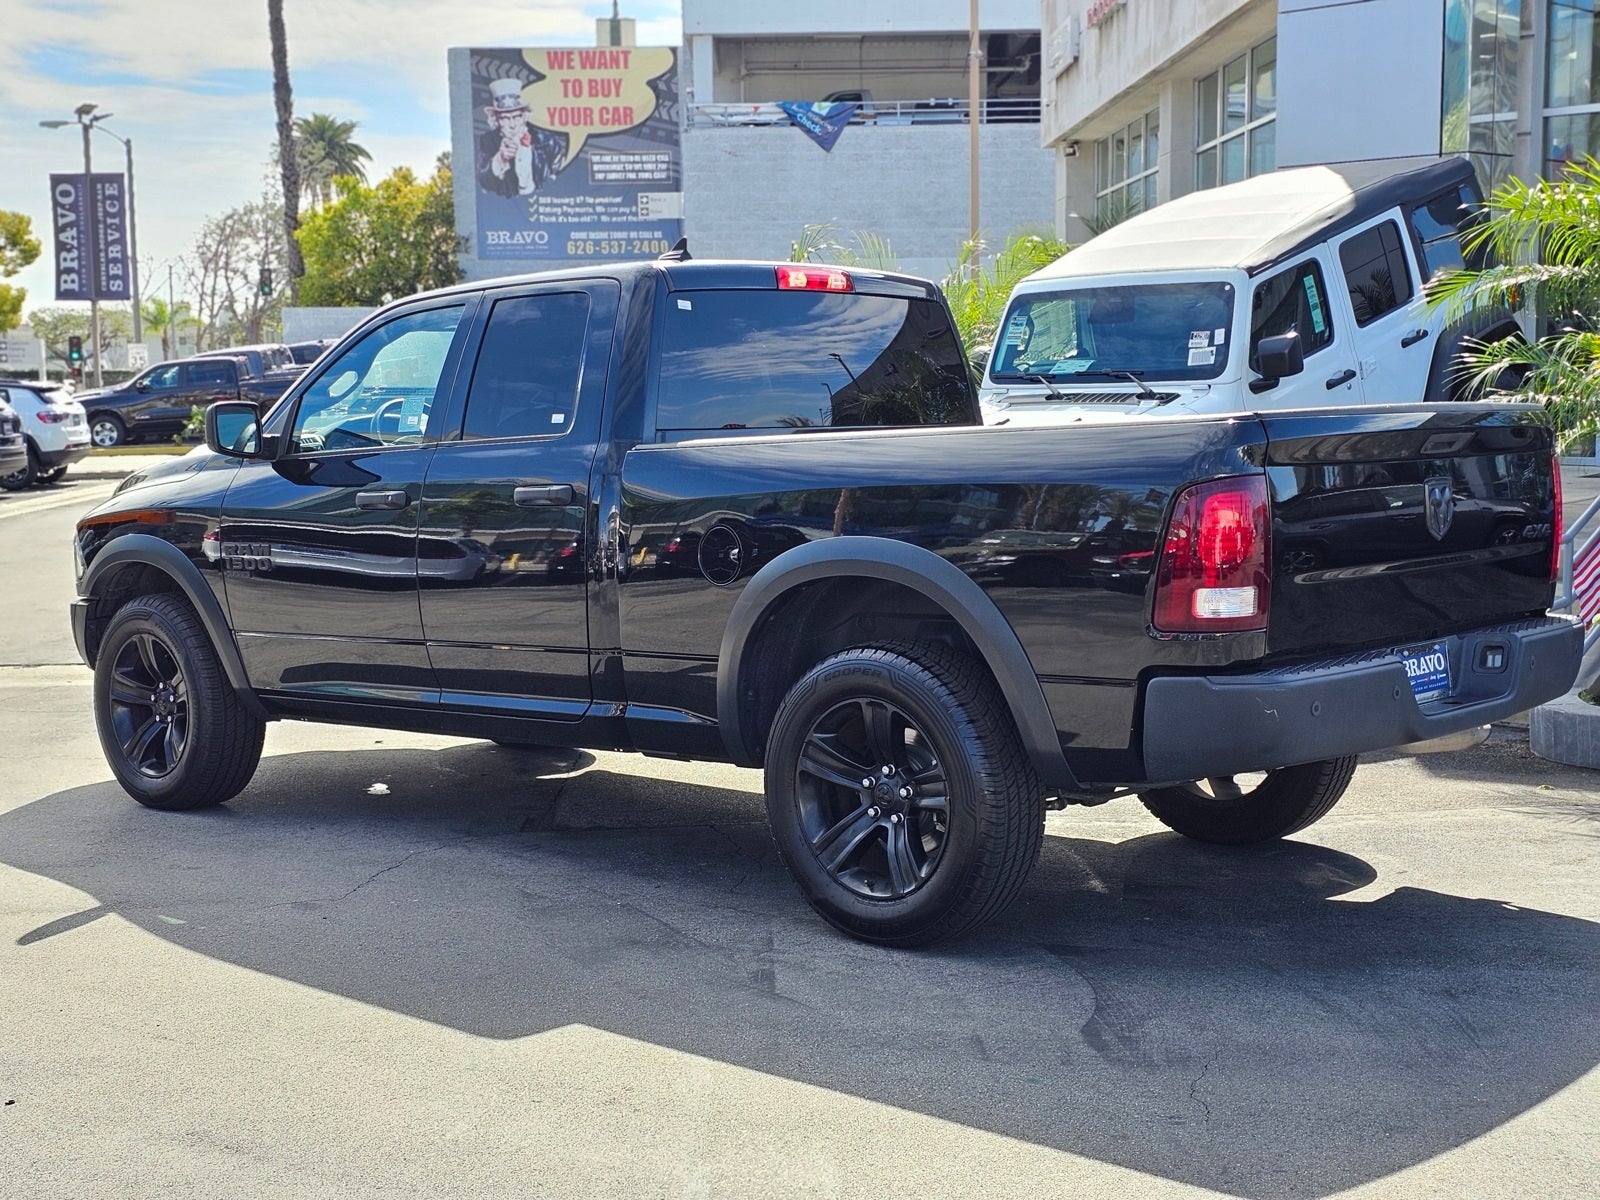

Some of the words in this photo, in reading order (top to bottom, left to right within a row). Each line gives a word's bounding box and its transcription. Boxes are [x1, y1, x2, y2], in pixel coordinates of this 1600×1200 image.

[546, 50, 576, 70] WE
[578, 50, 632, 70] WANT
[560, 78, 583, 98] TO
[587, 78, 623, 98] BUY
[546, 106, 594, 127] YOUR
[598, 106, 635, 126] CAR
[55, 183, 79, 292] BRAVO
[104, 183, 124, 292] SERVICE
[486, 231, 548, 244] BRAVO
[567, 239, 669, 255] 626-537-2400
[223, 543, 271, 557] RAM
[224, 557, 272, 571] 1500
[824, 667, 882, 682] COOPER
